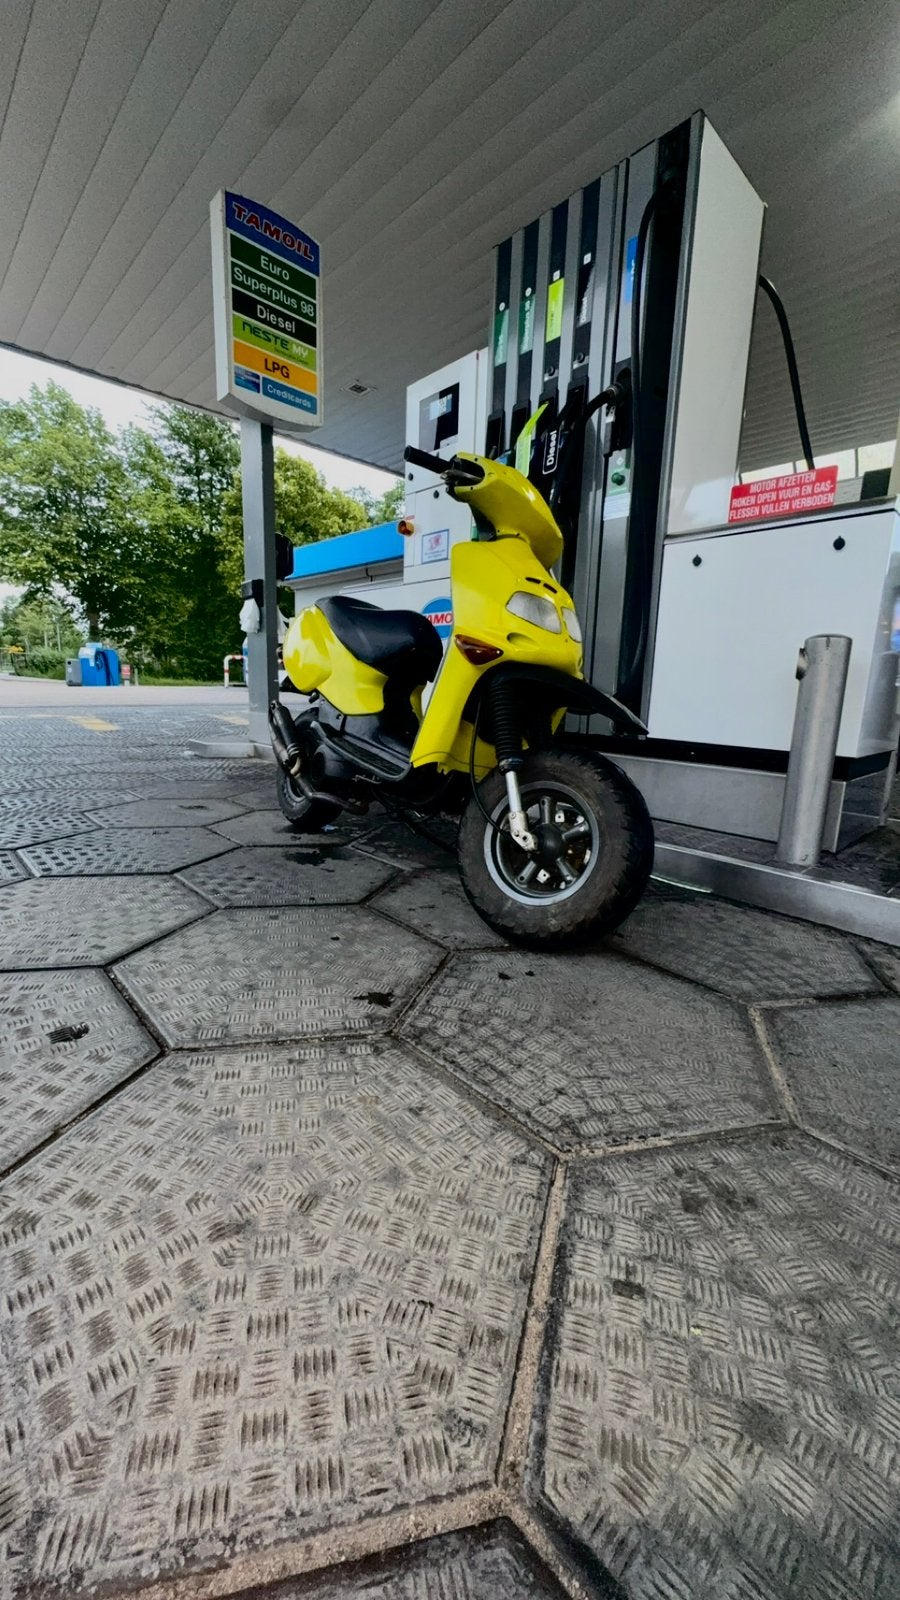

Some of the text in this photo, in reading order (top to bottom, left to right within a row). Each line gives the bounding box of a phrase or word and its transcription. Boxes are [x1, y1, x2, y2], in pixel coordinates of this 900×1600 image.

[232, 201, 315, 262] TAMOIL
[260, 255, 290, 280] Euro
[233, 267, 315, 317] Superplus 98
[257, 304, 296, 333] Diesel
[292, 343, 309, 358] MY
[264, 358, 290, 379] LPG
[267, 384, 312, 408] Creditcards
[546, 430, 557, 466] Diesel
[732, 480, 834, 508] ROKEN OPEN VUUR EN GAS-
[750, 472, 816, 494] MOTOR AFZETTEN
[729, 493, 834, 520] FLESSEN VULLEN VERBODEN
